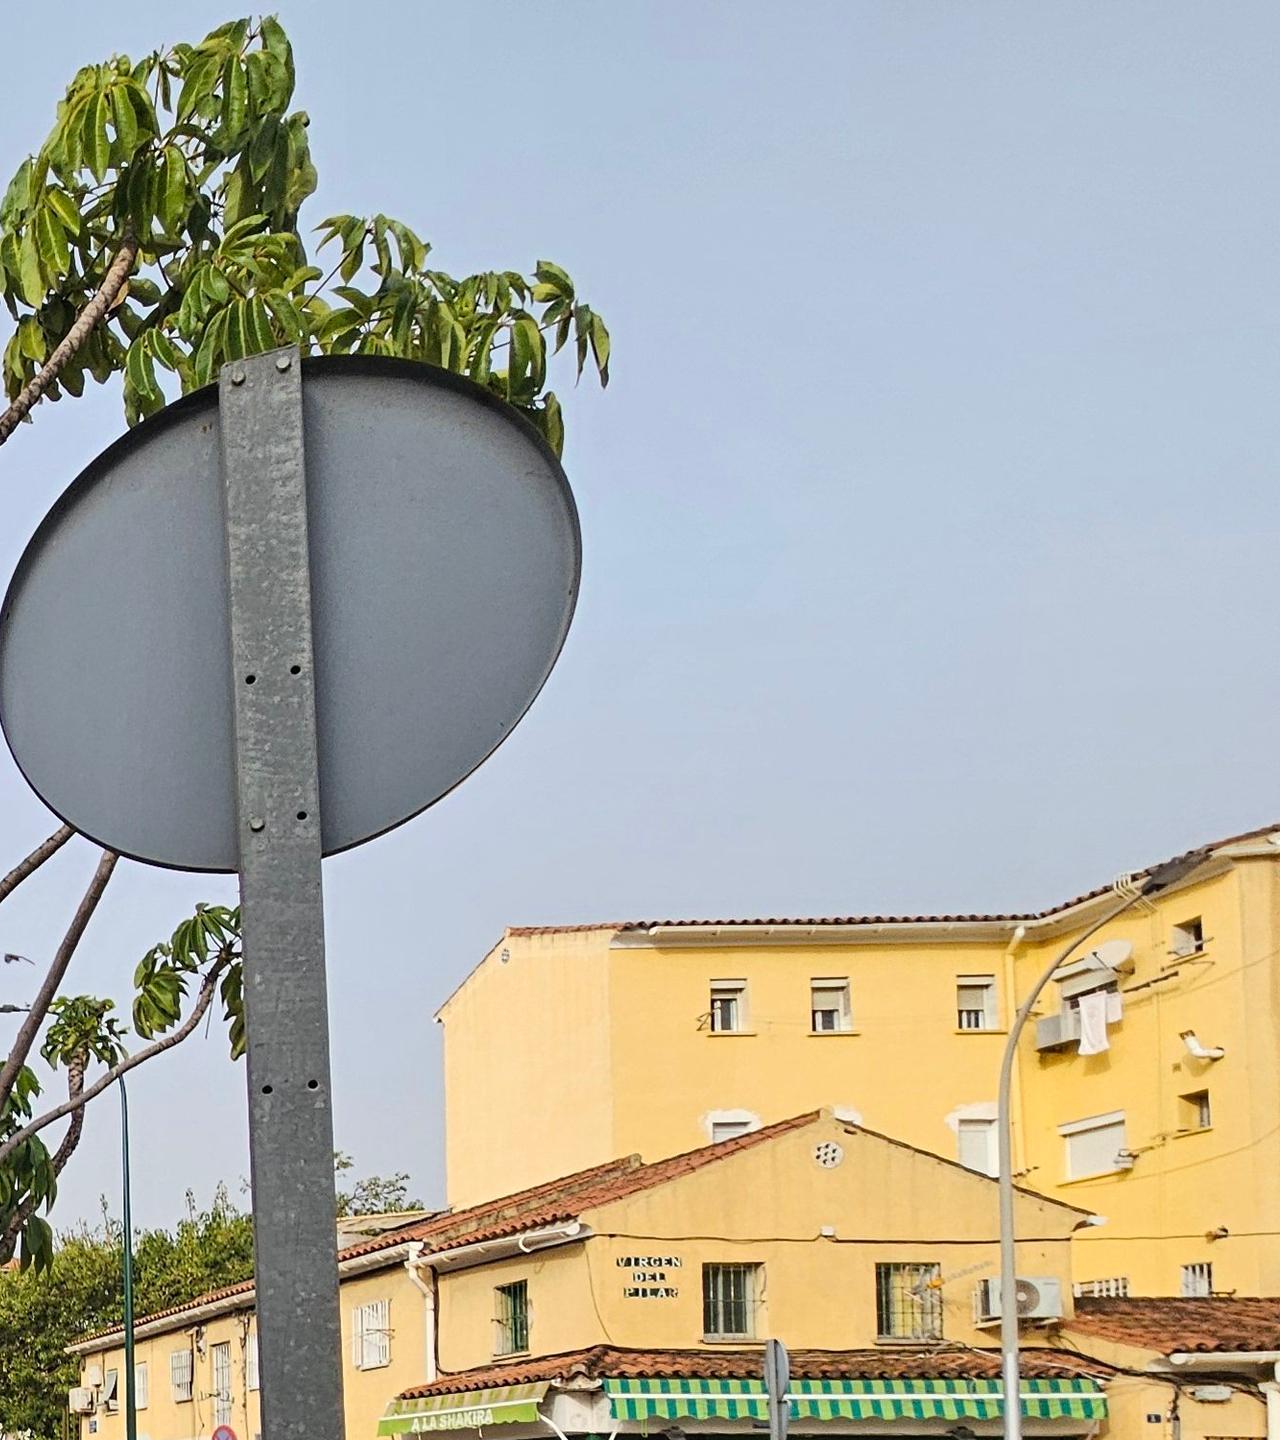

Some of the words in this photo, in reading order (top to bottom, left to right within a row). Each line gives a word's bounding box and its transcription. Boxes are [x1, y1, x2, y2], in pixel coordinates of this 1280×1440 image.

[616, 1256, 682, 1268] VIRGEN
[632, 1271, 666, 1282] DEL
[623, 1287, 679, 1299] PILAR
[439, 1408, 495, 1429] SHAKIRA
